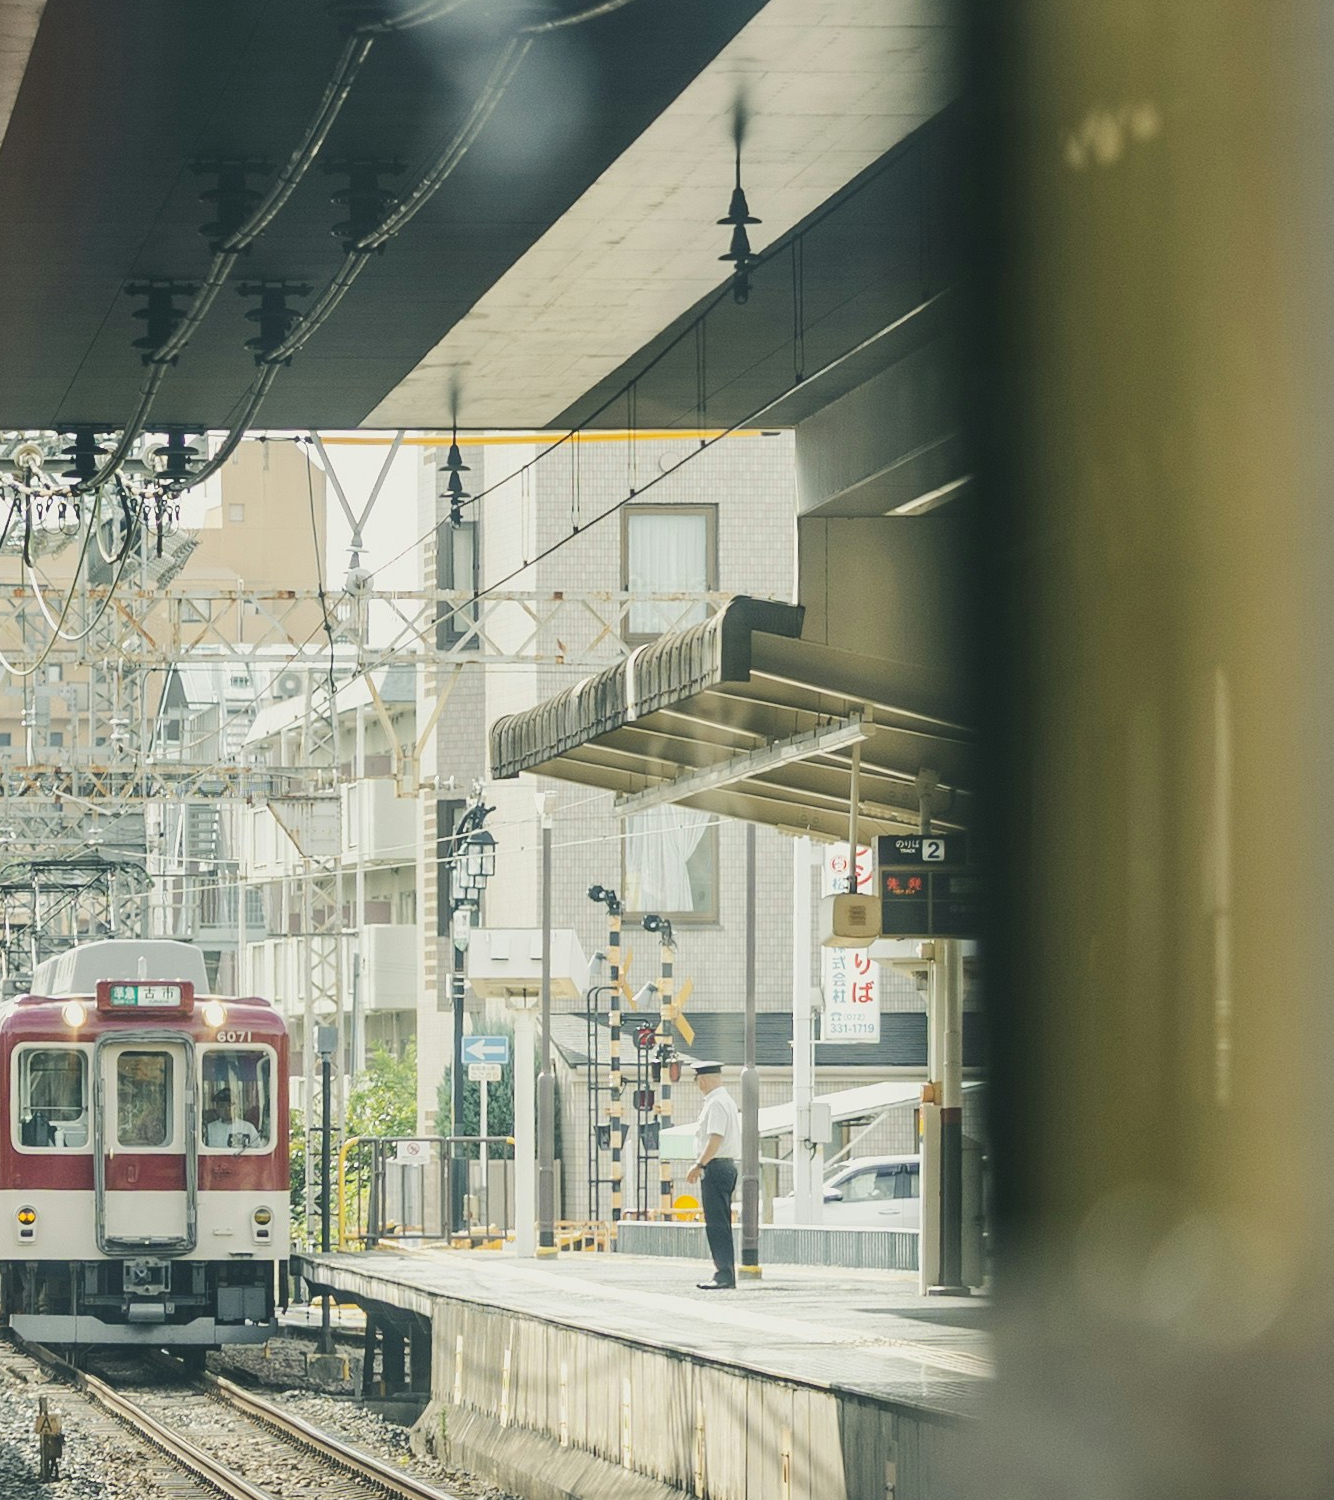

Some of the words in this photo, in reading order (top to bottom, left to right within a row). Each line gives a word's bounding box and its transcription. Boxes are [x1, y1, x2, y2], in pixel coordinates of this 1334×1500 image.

[895, 840, 920, 848] のりば
[927, 841, 940, 859] 2
[144, 986, 175, 1000] 古市
[830, 1023, 875, 1034] 331-1719
[217, 1031, 252, 1043] 6071
[40, 1416, 53, 1432] A
